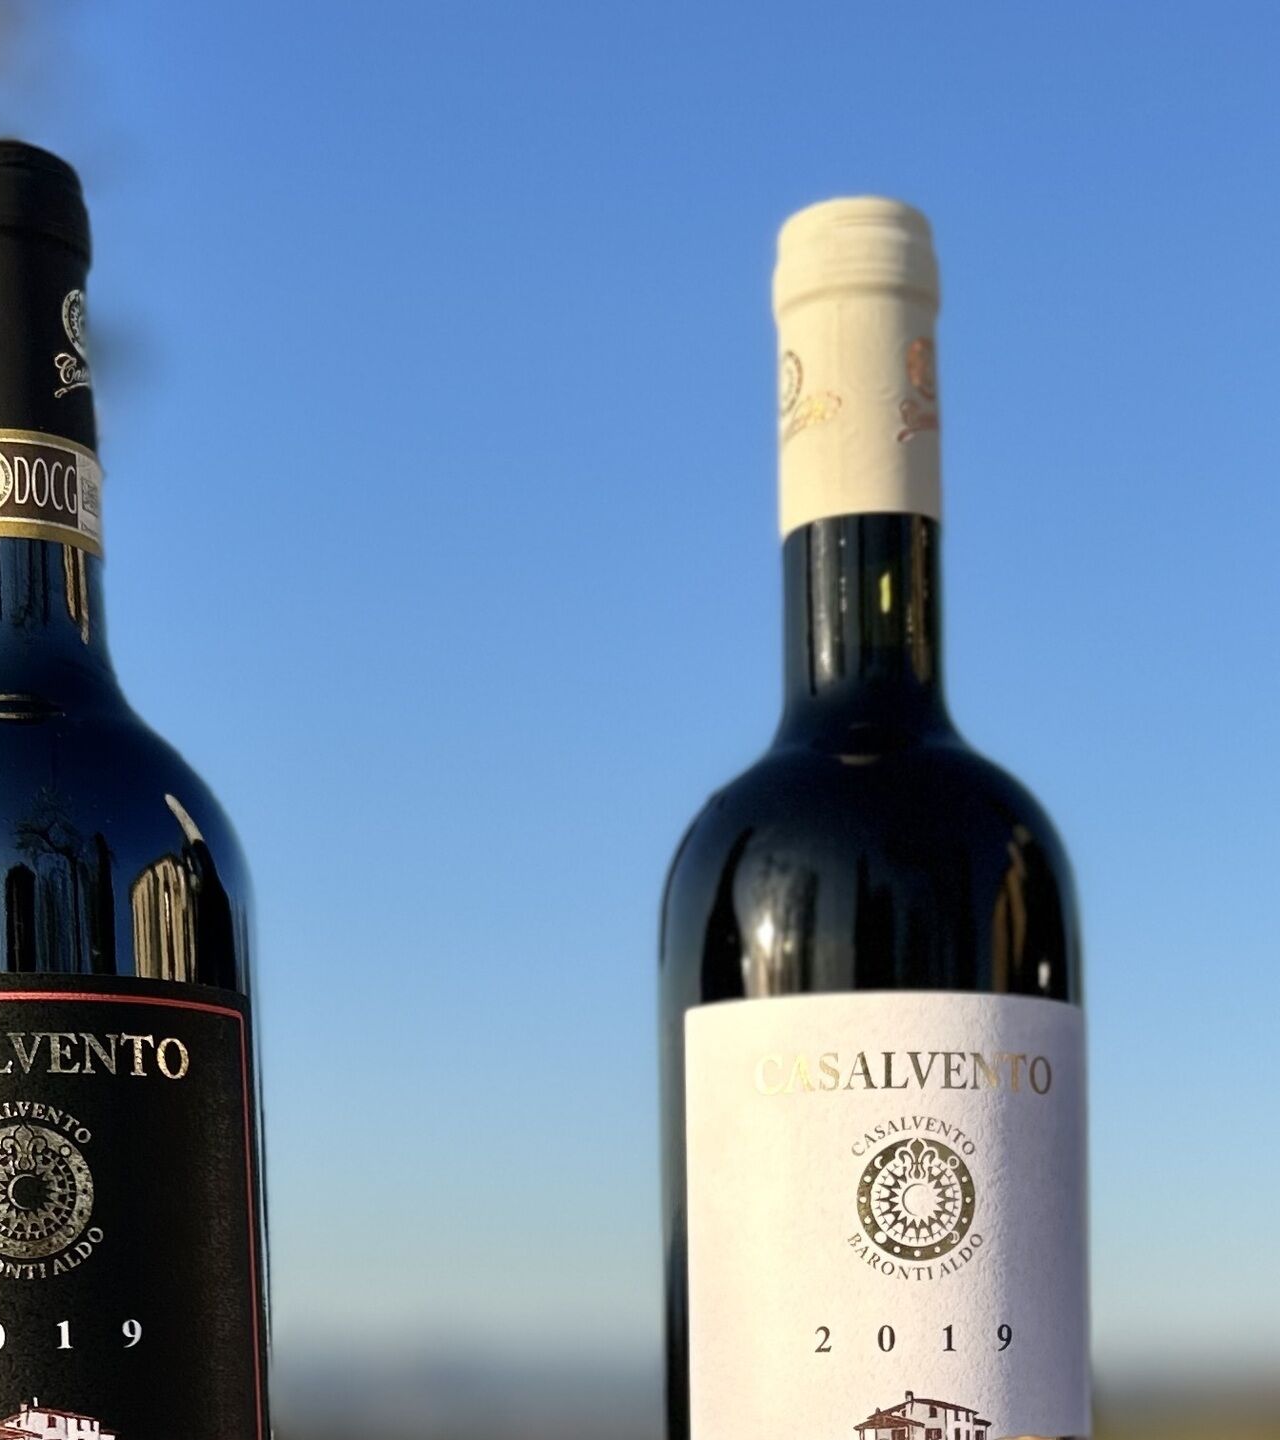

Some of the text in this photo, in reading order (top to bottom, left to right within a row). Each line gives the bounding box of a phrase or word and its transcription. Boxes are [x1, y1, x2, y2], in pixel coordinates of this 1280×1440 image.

[13, 456, 77, 514] DOCG
[754, 1050, 1052, 1095] CASALVENTO
[850, 1115, 977, 1158] CASALVENTO
[52, 1225, 105, 1277] ALDO
[846, 1231, 985, 1281] BARONTI ALDO
